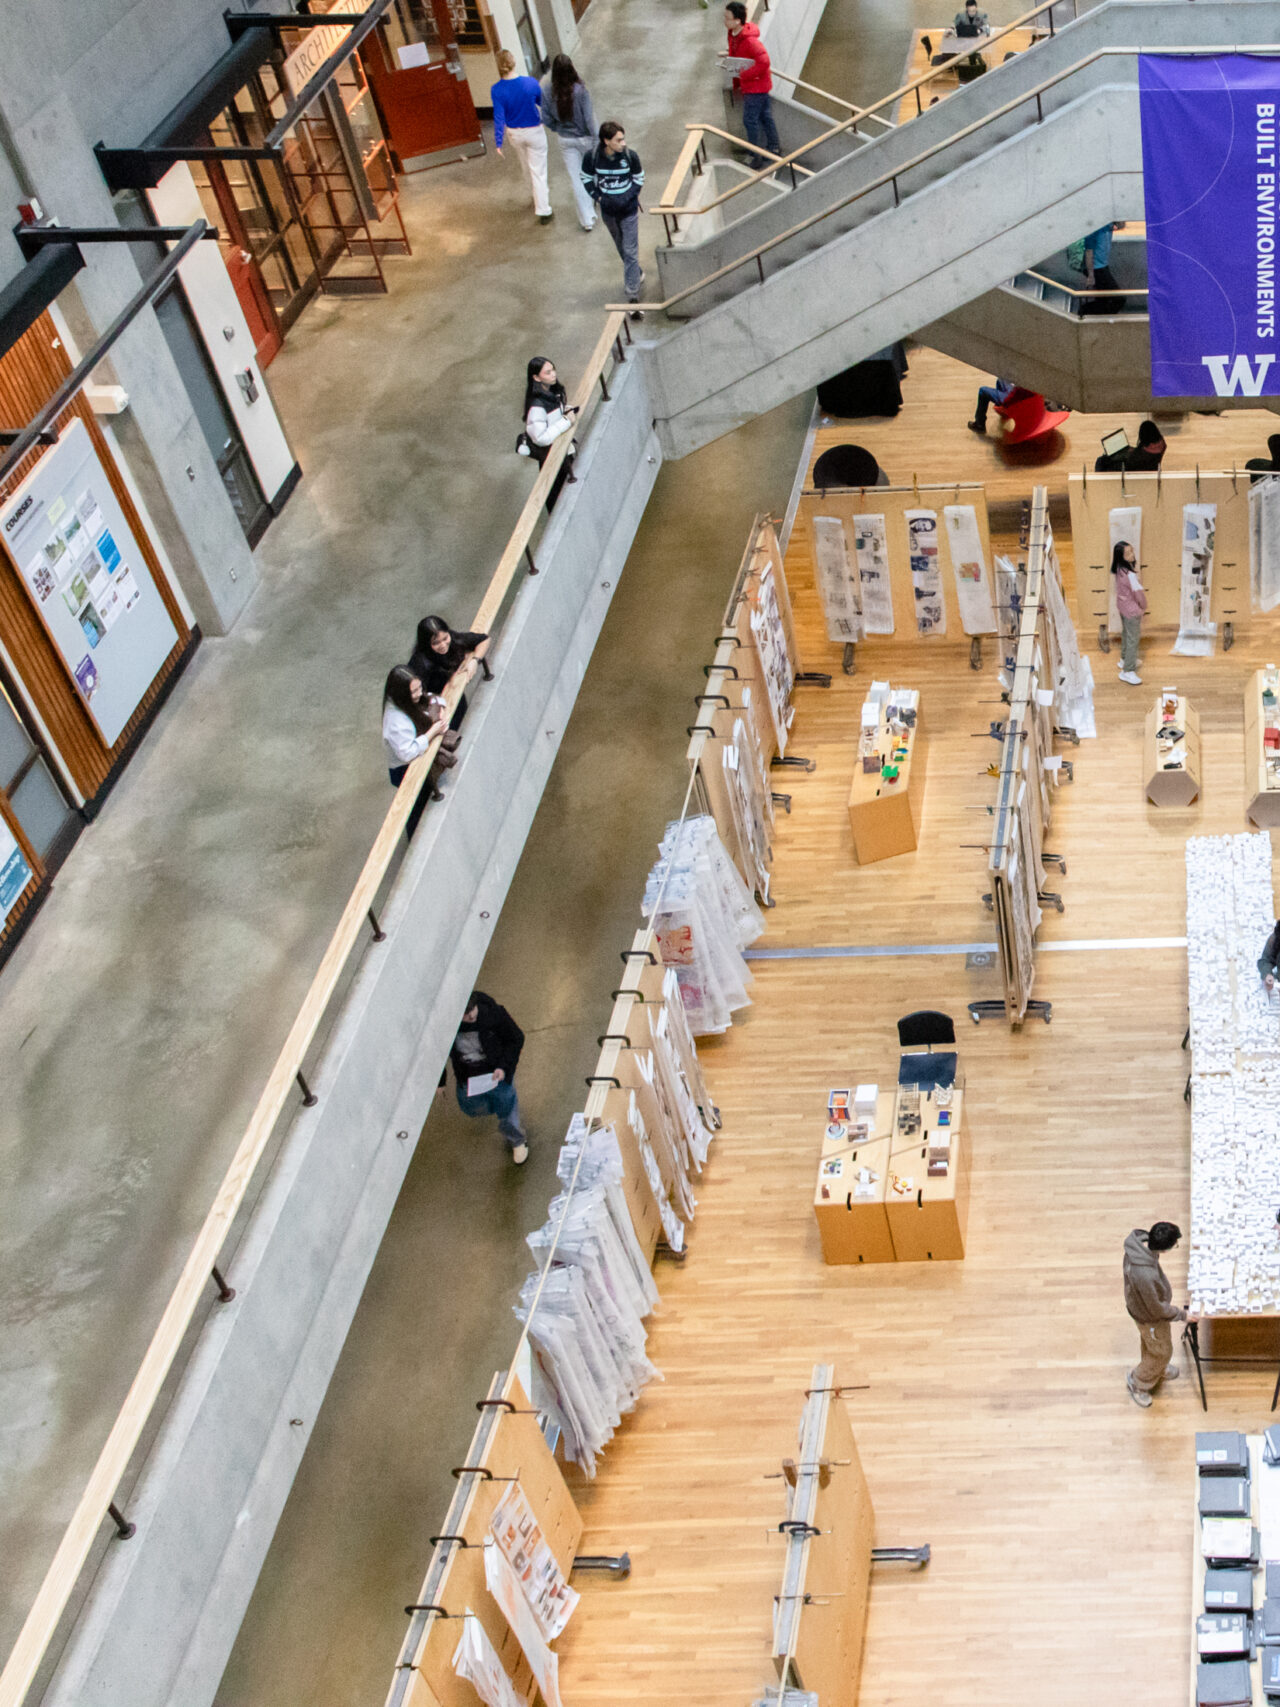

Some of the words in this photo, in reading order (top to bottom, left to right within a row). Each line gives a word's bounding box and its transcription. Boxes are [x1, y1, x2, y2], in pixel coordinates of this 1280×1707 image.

[1256, 103, 1276, 167] BUILT
[1256, 173, 1276, 338] ENVIRONMENTS
[1201, 353, 1276, 397] W
